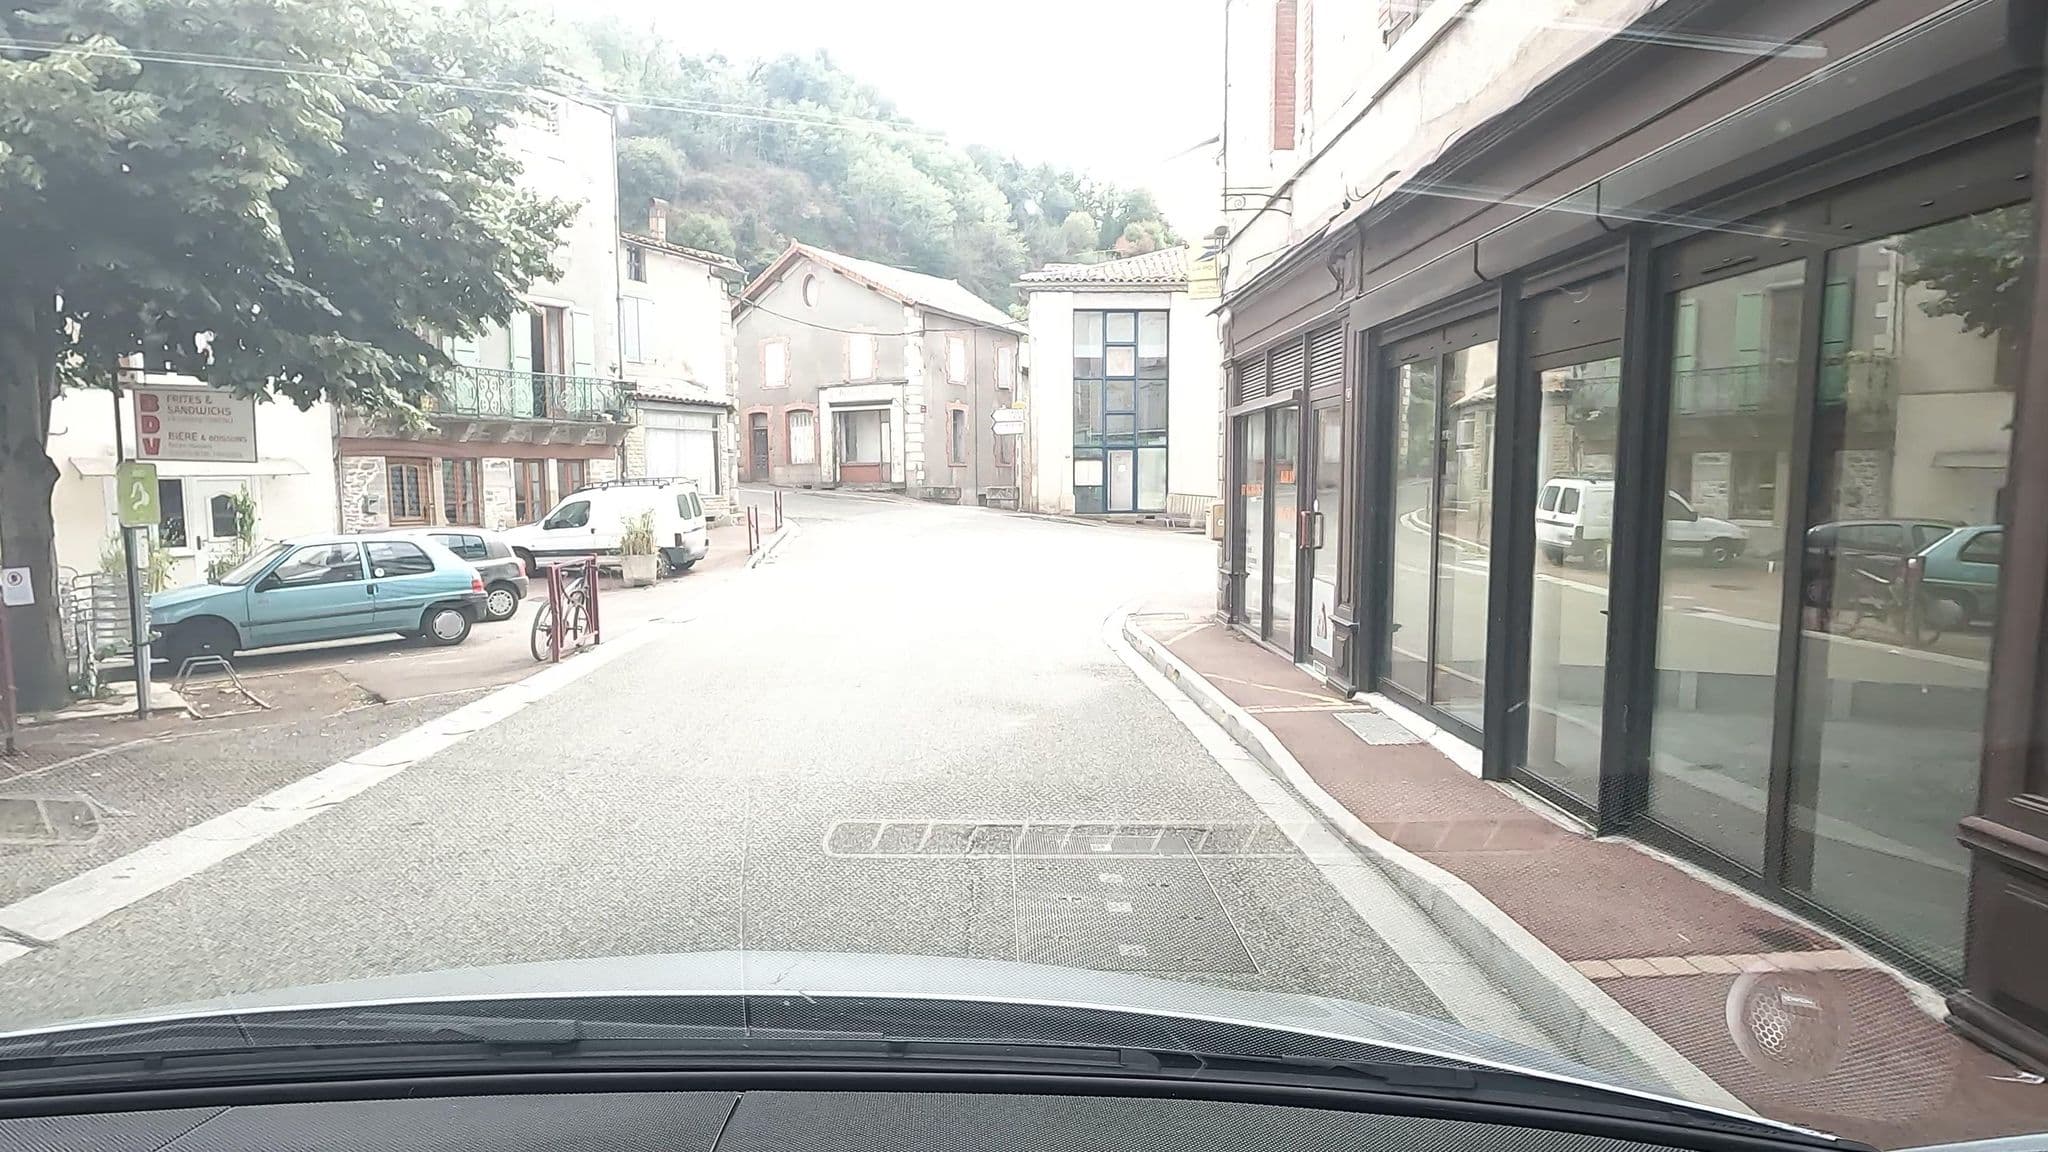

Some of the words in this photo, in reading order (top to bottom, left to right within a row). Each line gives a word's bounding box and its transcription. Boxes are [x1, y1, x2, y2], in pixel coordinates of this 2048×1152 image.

[166, 394, 202, 405] FRITES
[205, 395, 213, 405] &
[167, 406, 232, 416] SANDWICHS
